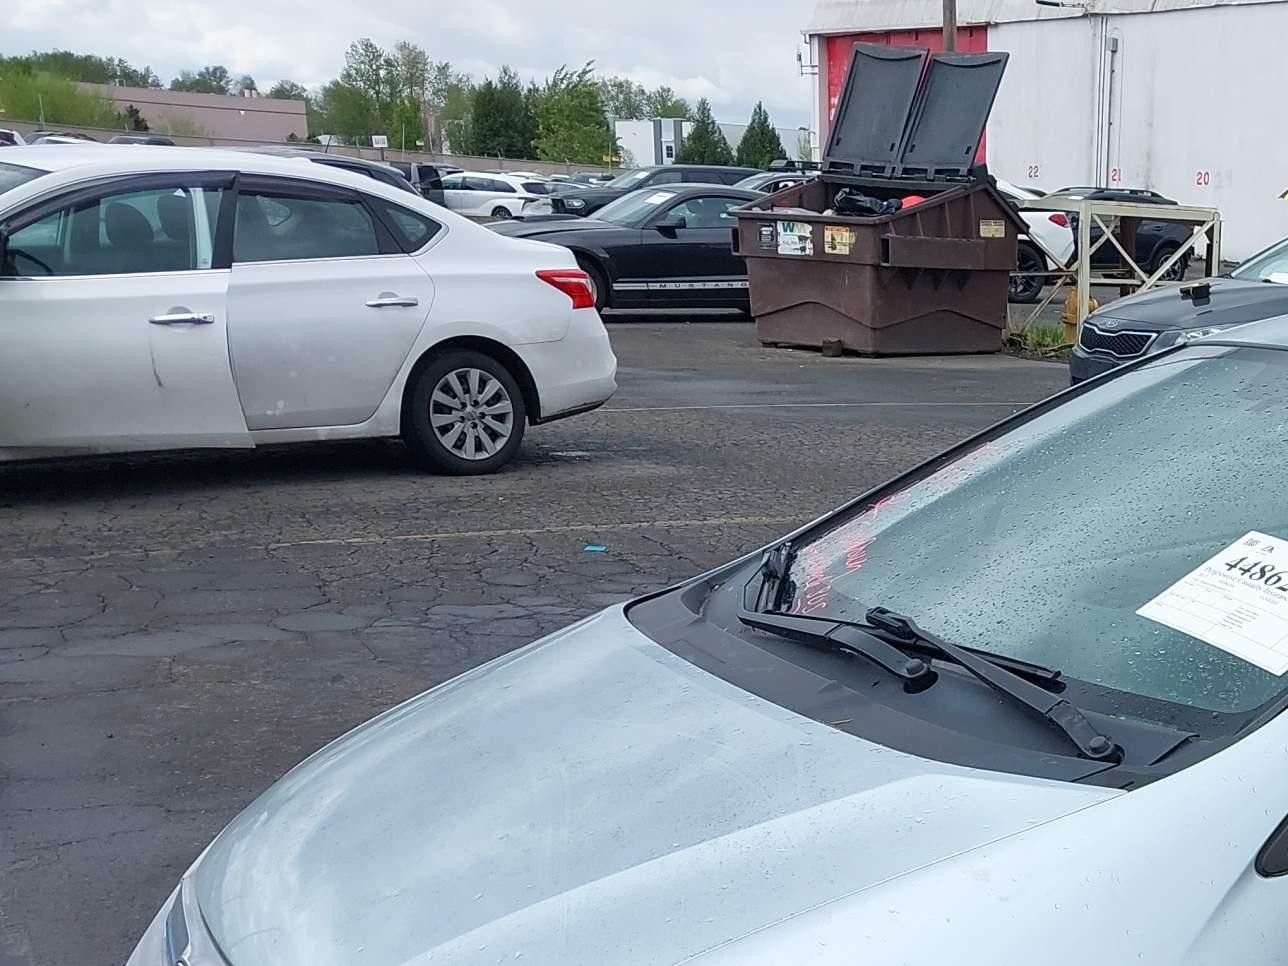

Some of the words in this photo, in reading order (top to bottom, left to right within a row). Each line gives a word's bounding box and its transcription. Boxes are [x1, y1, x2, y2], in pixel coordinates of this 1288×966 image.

[1028, 166, 1039, 178] 22
[1111, 168, 1121, 182] 21
[1196, 171, 1210, 186] 20
